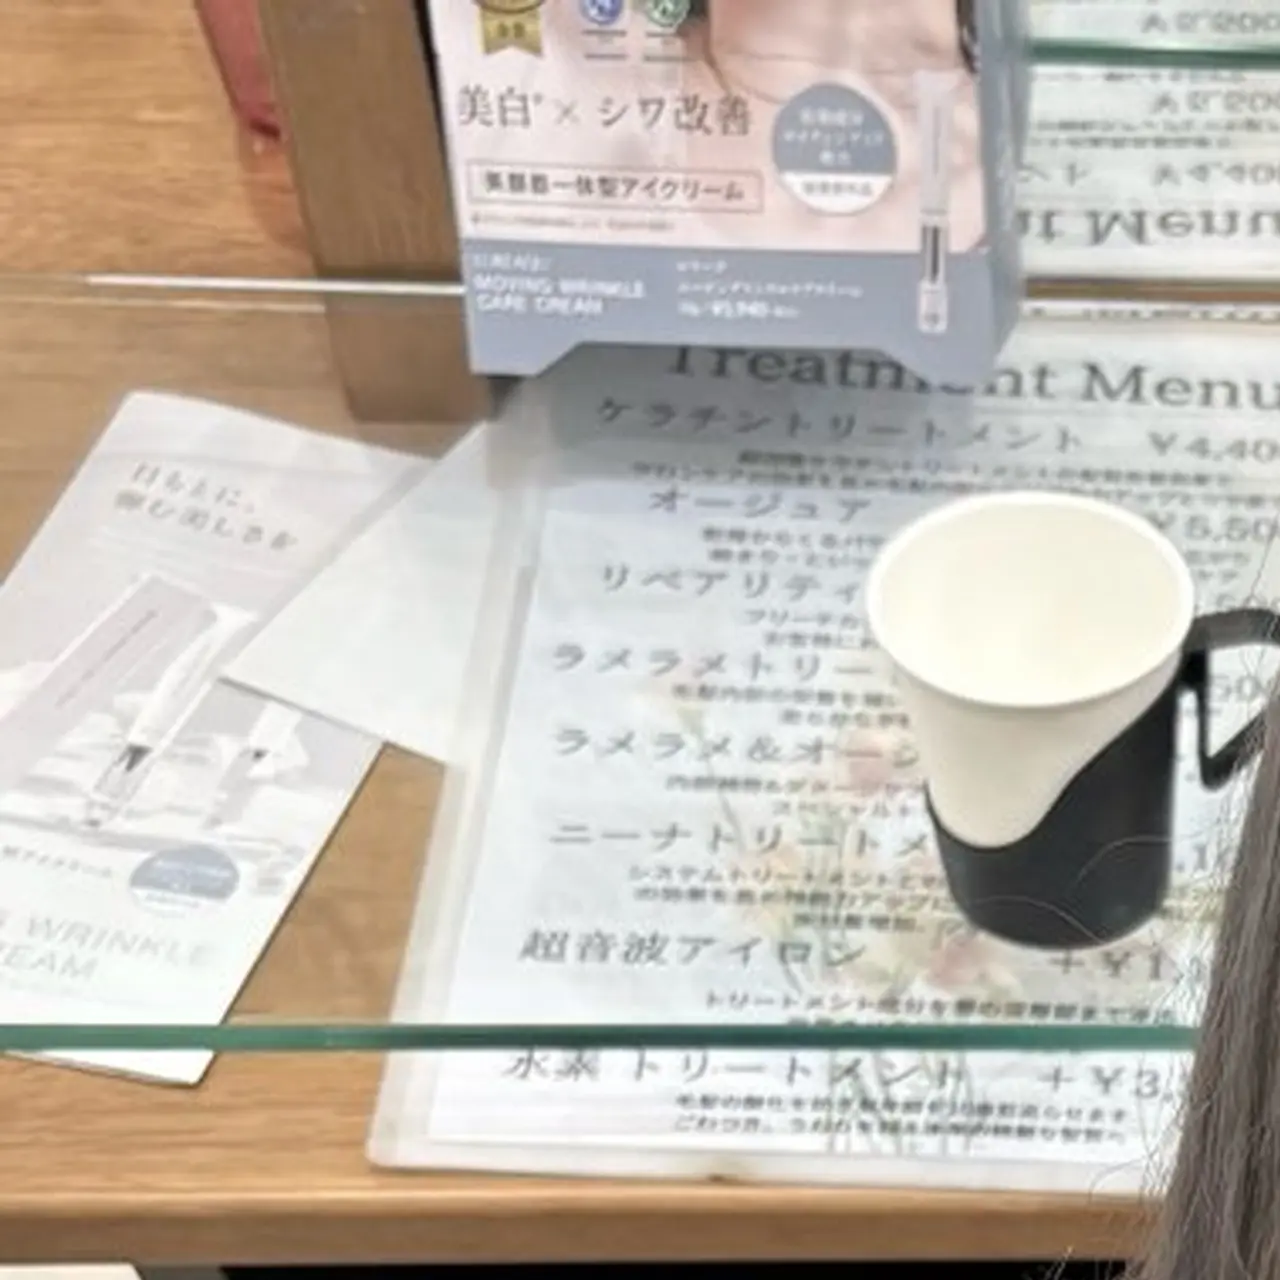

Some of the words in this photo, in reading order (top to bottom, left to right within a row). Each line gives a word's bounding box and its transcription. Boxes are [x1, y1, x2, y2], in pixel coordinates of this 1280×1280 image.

[667, 344, 1060, 399] Treatmnt
[598, 396, 1083, 454] ケラチントリートメント
[650, 485, 872, 522] オージュア
[517, 928, 868, 968] 超音波アイロン
